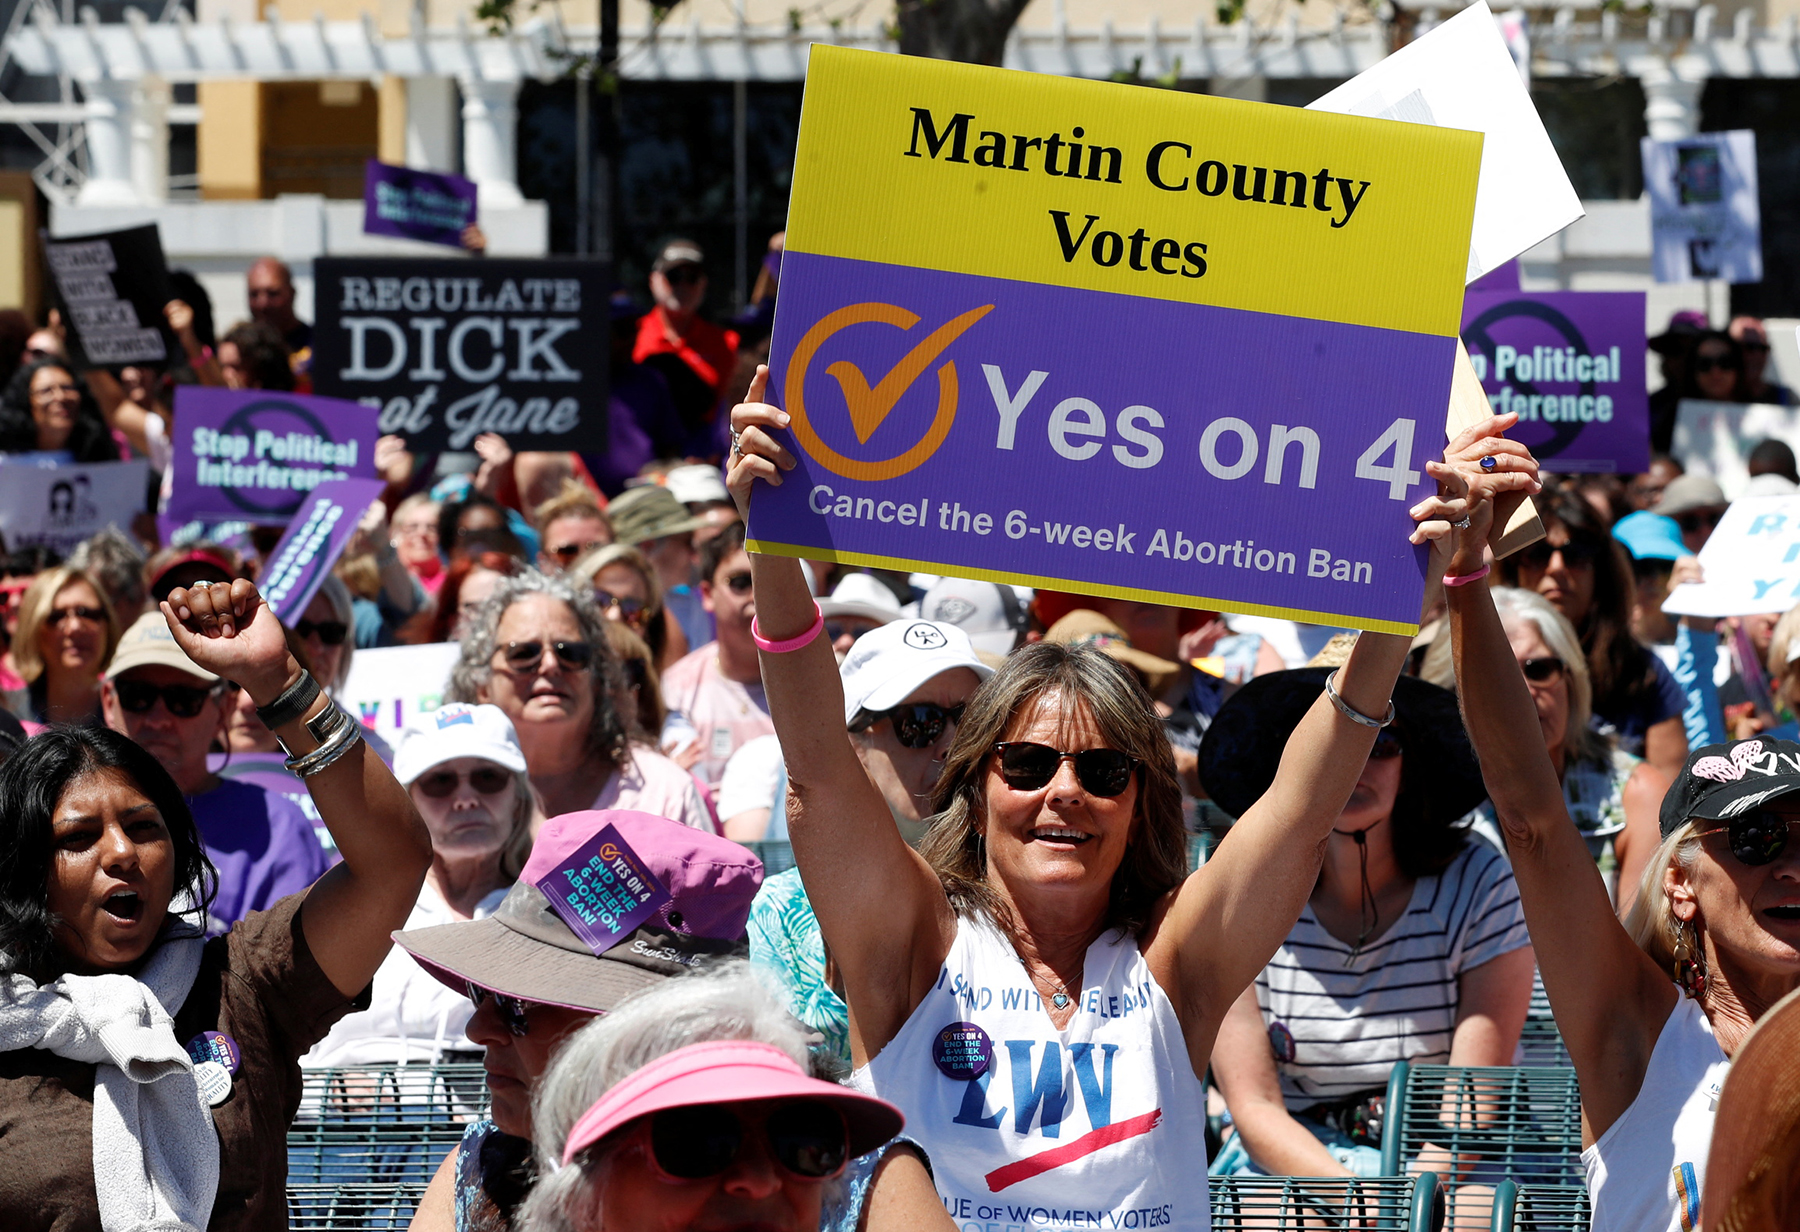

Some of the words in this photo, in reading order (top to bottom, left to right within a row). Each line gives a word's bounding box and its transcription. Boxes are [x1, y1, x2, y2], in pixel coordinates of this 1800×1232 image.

[903, 107, 1123, 184] Martin
[1145, 140, 1371, 229] County
[1048, 209, 1208, 279] Votes
[340, 276, 582, 313] REGULATE
[339, 316, 582, 383] DICK
[1494, 345, 1620, 382] Political
[444, 384, 580, 449] Jane
[1487, 386, 1614, 423] rference
[192, 426, 250, 463] Stop
[254, 429, 359, 468] Political
[981, 363, 1165, 469] Yes
[1199, 416, 1321, 489] on
[1354, 417, 1421, 501] 4
[808, 484, 929, 527] Cancel
[938, 502, 993, 535] the
[1004, 509, 1137, 554] 6-week
[1145, 528, 1296, 575] Abortion
[1307, 548, 1373, 584] Ban
[562, 868, 622, 935] ABORTION
[580, 867, 626, 919] 6-WEEK
[589, 855, 615, 885] END
[613, 883, 638, 912] THE
[611, 856, 632, 880] YES
[626, 876, 645, 895] ON
[640, 892, 651, 903] 4
[566, 892, 598, 927] BAN!
[209, 1039, 219, 1056] END
[940, 1055, 985, 1063] ABORTION
[953, 1033, 965, 1041] YES
[966, 1032, 976, 1040] ON
[977, 1032, 982, 1040] 4
[977, 1205, 1002, 1220] OF
[1007, 1206, 1102, 1230] WOMEN
